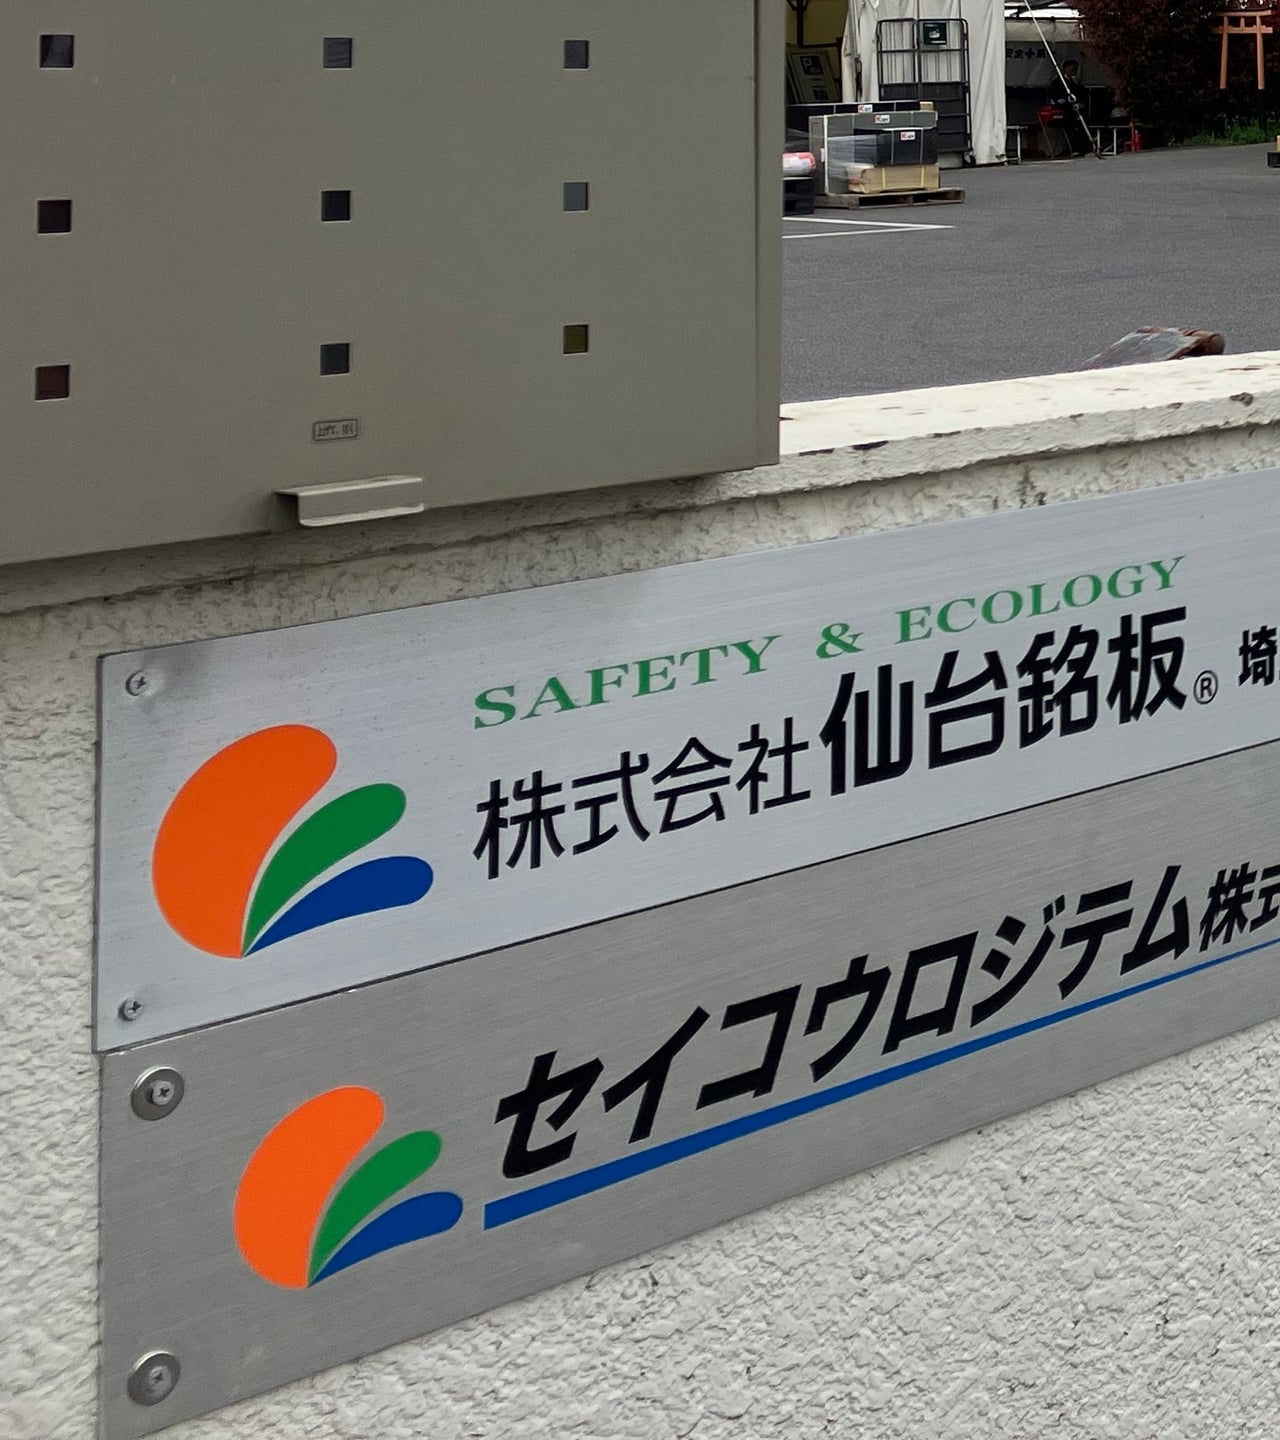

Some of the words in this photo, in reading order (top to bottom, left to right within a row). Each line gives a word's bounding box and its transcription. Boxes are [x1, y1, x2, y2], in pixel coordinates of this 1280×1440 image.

[472, 634, 781, 730] SAFETY
[815, 621, 867, 660] &
[897, 555, 1187, 645] ECOLOGY
